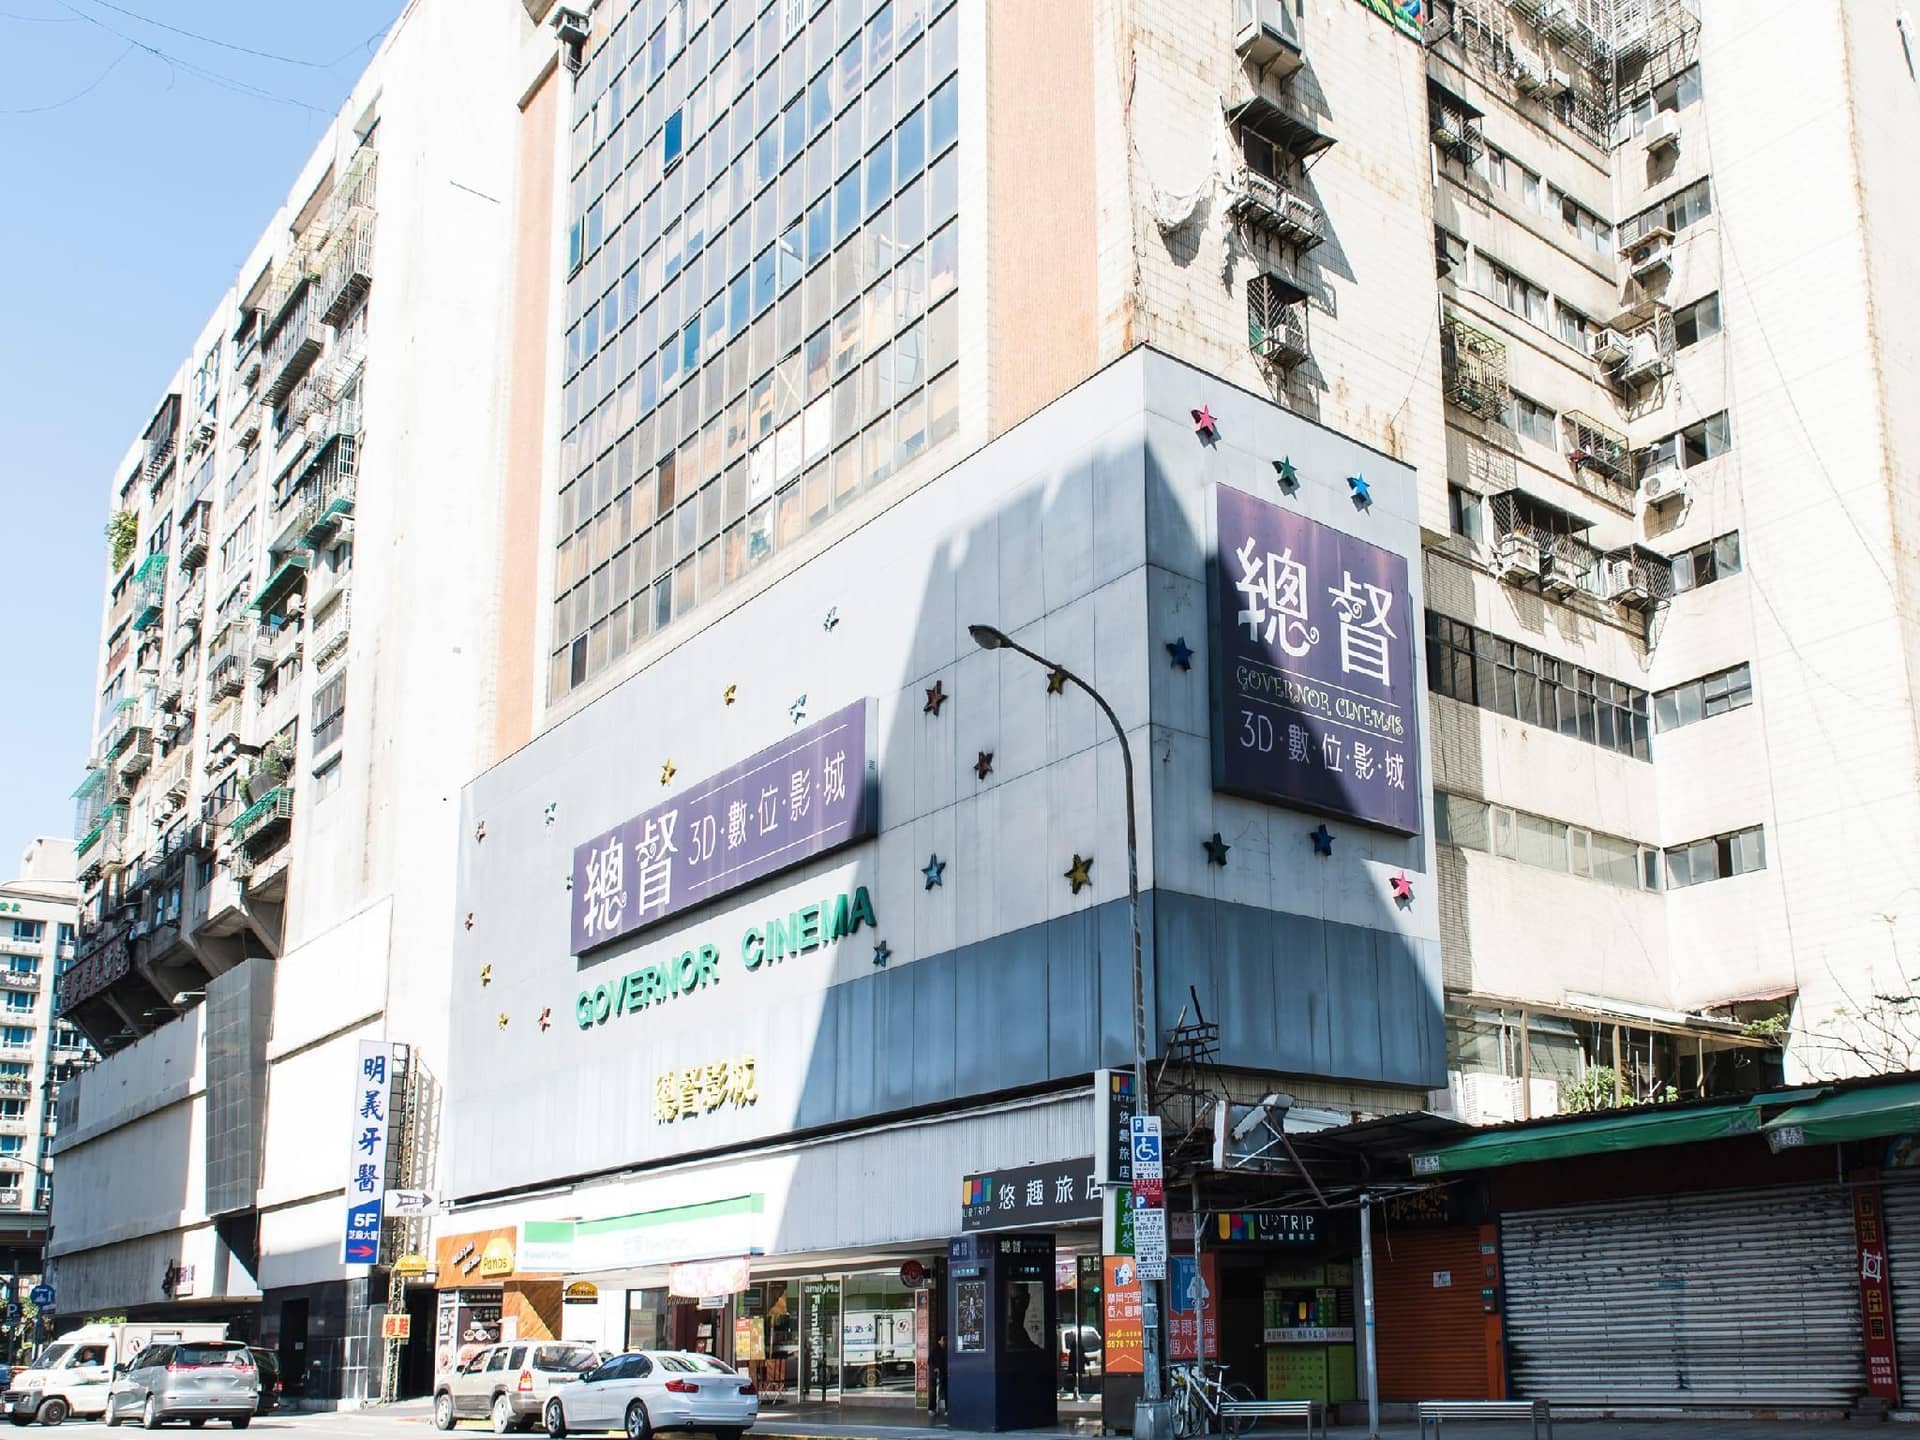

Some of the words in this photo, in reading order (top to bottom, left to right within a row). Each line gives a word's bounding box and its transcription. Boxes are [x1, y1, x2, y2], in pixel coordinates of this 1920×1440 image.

[1235, 536, 1398, 687] 總督
[1236, 664, 1332, 717] GOVERNOR
[1335, 696, 1404, 736] CINEMAS
[583, 808, 679, 938] 總督
[576, 943, 720, 1030] GOVERNOR
[742, 886, 877, 971] CINEMA
[353, 1055, 386, 1193] 明義牙醫
[1135, 1119, 1142, 1131] P
[998, 1171, 1103, 1210] 悠趣旅店
[1136, 1196, 1146, 1209] P
[354, 1212, 377, 1228] 5F
[483, 1256, 508, 1271] Panos
[7, 1303, 18, 1317] P
[809, 1294, 823, 1383] FamilyMart
